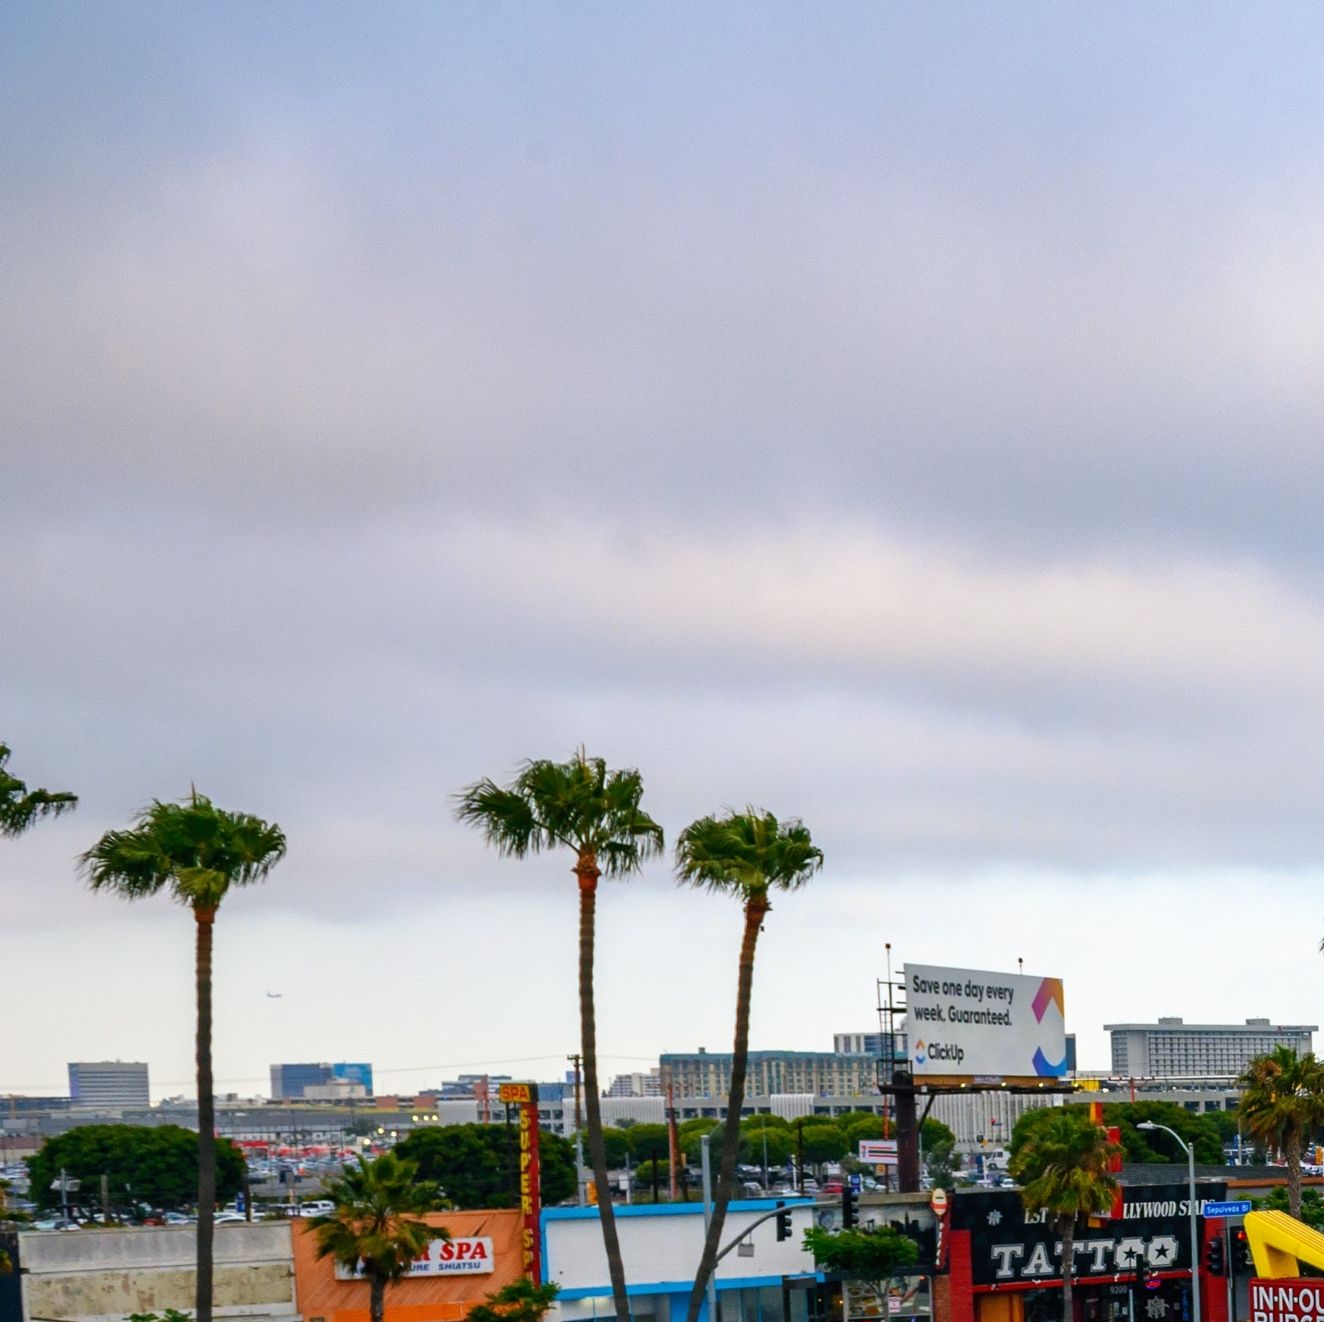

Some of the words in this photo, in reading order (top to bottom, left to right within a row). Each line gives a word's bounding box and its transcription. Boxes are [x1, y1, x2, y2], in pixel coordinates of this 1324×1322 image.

[912, 975, 940, 995] Save
[942, 984, 962, 996] one
[964, 980, 985, 1003] day
[986, 985, 1014, 1005] every
[914, 1004, 946, 1022] week.
[948, 1006, 1013, 1027] Guaranteed.
[927, 1042, 965, 1066] ClickUp
[501, 1085, 528, 1099] SPA
[520, 1108, 532, 1215] SUPER
[1206, 1205, 1240, 1215] Sepulveda
[439, 1241, 488, 1261] SPA
[991, 1234, 1180, 1279] TATTOO
[438, 1261, 481, 1271] SHIATSU
